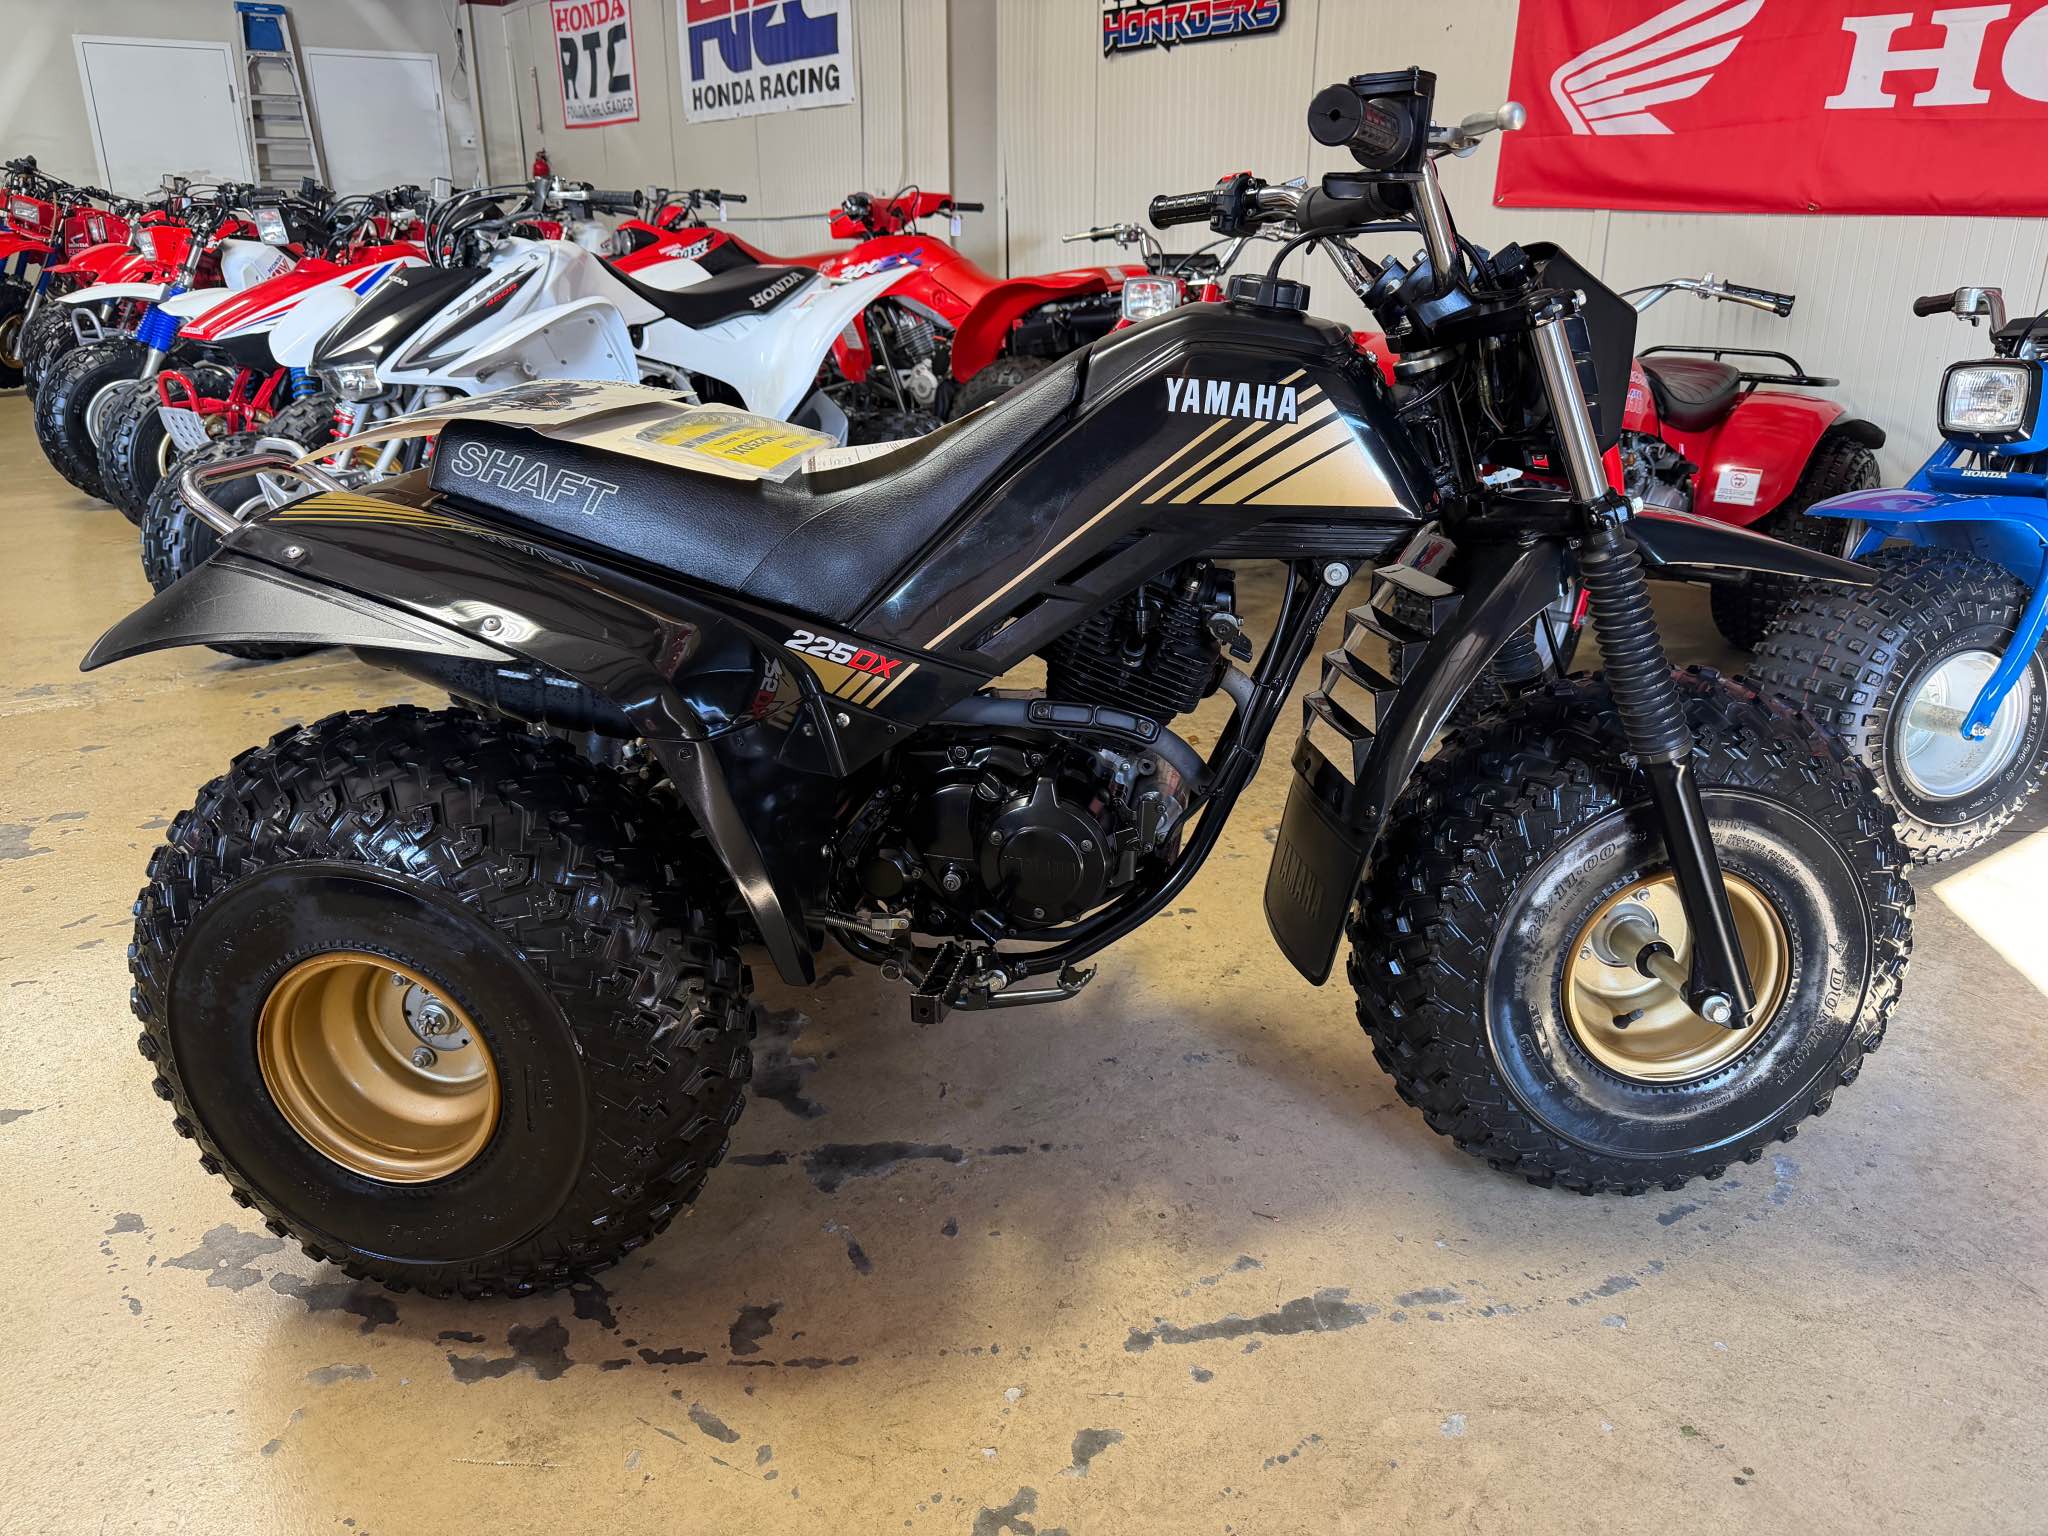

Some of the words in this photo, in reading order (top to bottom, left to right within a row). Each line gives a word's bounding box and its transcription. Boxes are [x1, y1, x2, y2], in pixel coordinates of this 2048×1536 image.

[555, 0, 625, 32] HONDA
[1104, 0, 1281, 51] HOARDERS
[602, 97, 634, 116] LEADER
[692, 79, 755, 111] HONDA
[760, 64, 840, 101] RACING
[749, 271, 806, 309] HONDA
[1166, 377, 1297, 422] YAMAHA
[451, 441, 620, 515] SHAFT
[1961, 469, 2008, 479] HONDA
[784, 629, 903, 679] 225DX
[1709, 819, 1747, 832] AUTION
